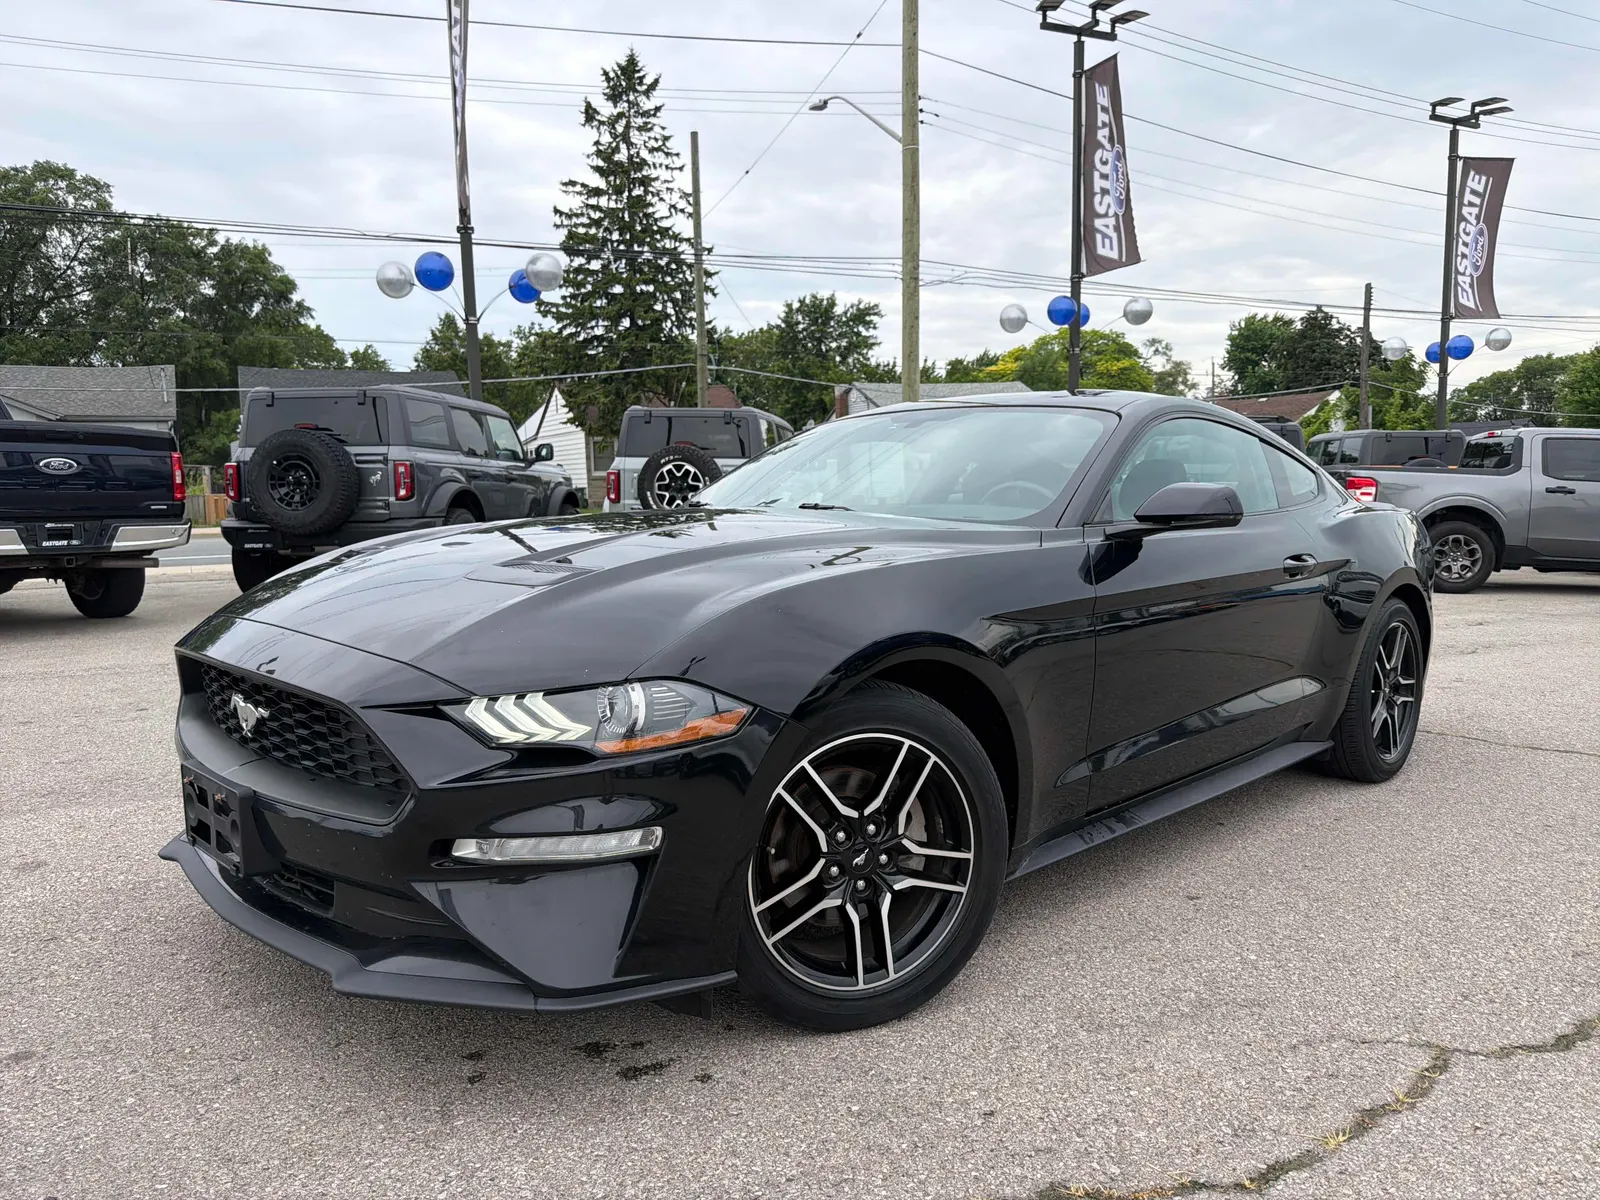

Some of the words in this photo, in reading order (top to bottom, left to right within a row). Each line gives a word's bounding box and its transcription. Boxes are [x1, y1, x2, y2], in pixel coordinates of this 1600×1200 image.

[1094, 81, 1119, 262] EASTGATE
[1113, 160, 1125, 200] Ford
[1456, 168, 1487, 311] EASTGATE
[1470, 235, 1485, 266] Ford
[49, 460, 70, 471] Ford
